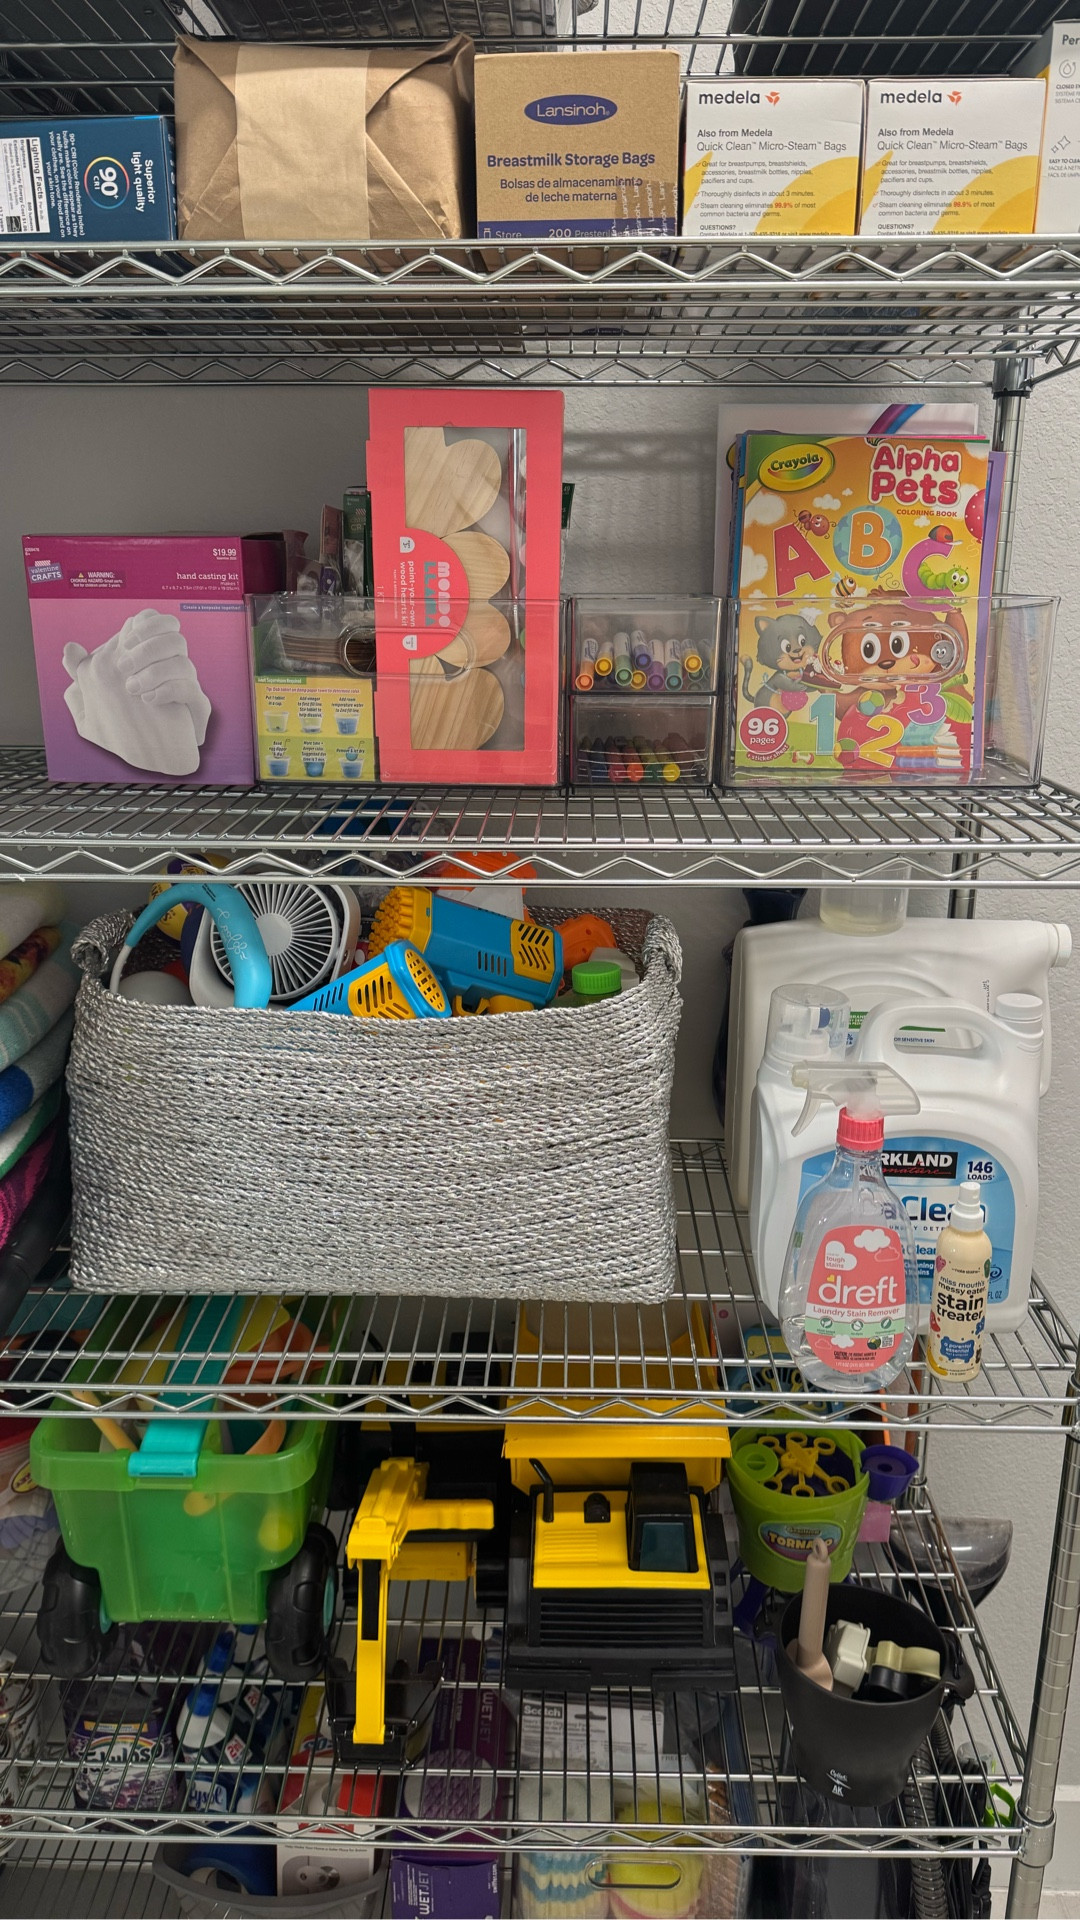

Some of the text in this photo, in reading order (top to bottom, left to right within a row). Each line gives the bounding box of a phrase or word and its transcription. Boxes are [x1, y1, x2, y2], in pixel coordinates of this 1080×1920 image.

[699, 90, 760, 104] medela
[880, 90, 942, 104] medela
[537, 103, 605, 117] Lansinoh
[697, 129, 773, 137] Also from Medela
[878, 127, 954, 137] Also from Medela
[697, 142, 723, 151] Quick
[824, 141, 846, 152] Bags
[877, 141, 903, 150] Quick
[1005, 140, 1027, 151] Bags
[487, 152, 655, 167] Breastmilk Storage Bags
[729, 160, 766, 169] breastpumps,
[769, 160, 807, 168] breastshields,
[31, 139, 44, 199] Lighting Facts
[769, 168, 790, 176] bottles,
[791, 168, 813, 176] nipples,
[131, 152, 144, 212] light quality
[144, 160, 155, 204] Superior
[500, 178, 534, 189] Bolsas
[537, 178, 550, 188] de
[701, 177, 725, 185] pacifiers
[526, 191, 617, 202] de leche materna
[55, 175, 59, 183] on
[61, 229, 65, 237] on
[71, 214, 76, 222] as
[67, 227, 71, 235] on
[495, 230, 522, 238] Store
[549, 228, 571, 238] 200
[769, 452, 821, 472] Crayola
[872, 445, 960, 476] Alpha
[871, 470, 960, 505] Pets
[896, 508, 958, 518] COLORING BOOK
[213, 548, 236, 556] $19.99
[773, 511, 956, 612] A B C
[31, 572, 61, 581] CRAFTS
[198, 573, 226, 581] casting
[400, 562, 408, 585] wood
[407, 561, 416, 627] paint-your-own
[424, 561, 436, 626] LLAMA
[400, 588, 408, 614] hearts
[906, 682, 947, 725] 3
[748, 718, 779, 736] 96
[809, 693, 905, 768] 1 2
[750, 735, 776, 746] pages
[751, 744, 789, 761] sticker sheet
[968, 1161, 993, 1173] 146
[827, 1256, 845, 1264] tough
[939, 1281, 965, 1295] messy
[940, 1276, 985, 1288] miss mouth's
[819, 1275, 898, 1305] dreft
[937, 1292, 983, 1310] stain
[813, 1306, 845, 1317] Laundry
[868, 1308, 899, 1316] Remover
[937, 1304, 982, 1321] treater
[768, 1531, 833, 1549] TORNAO
